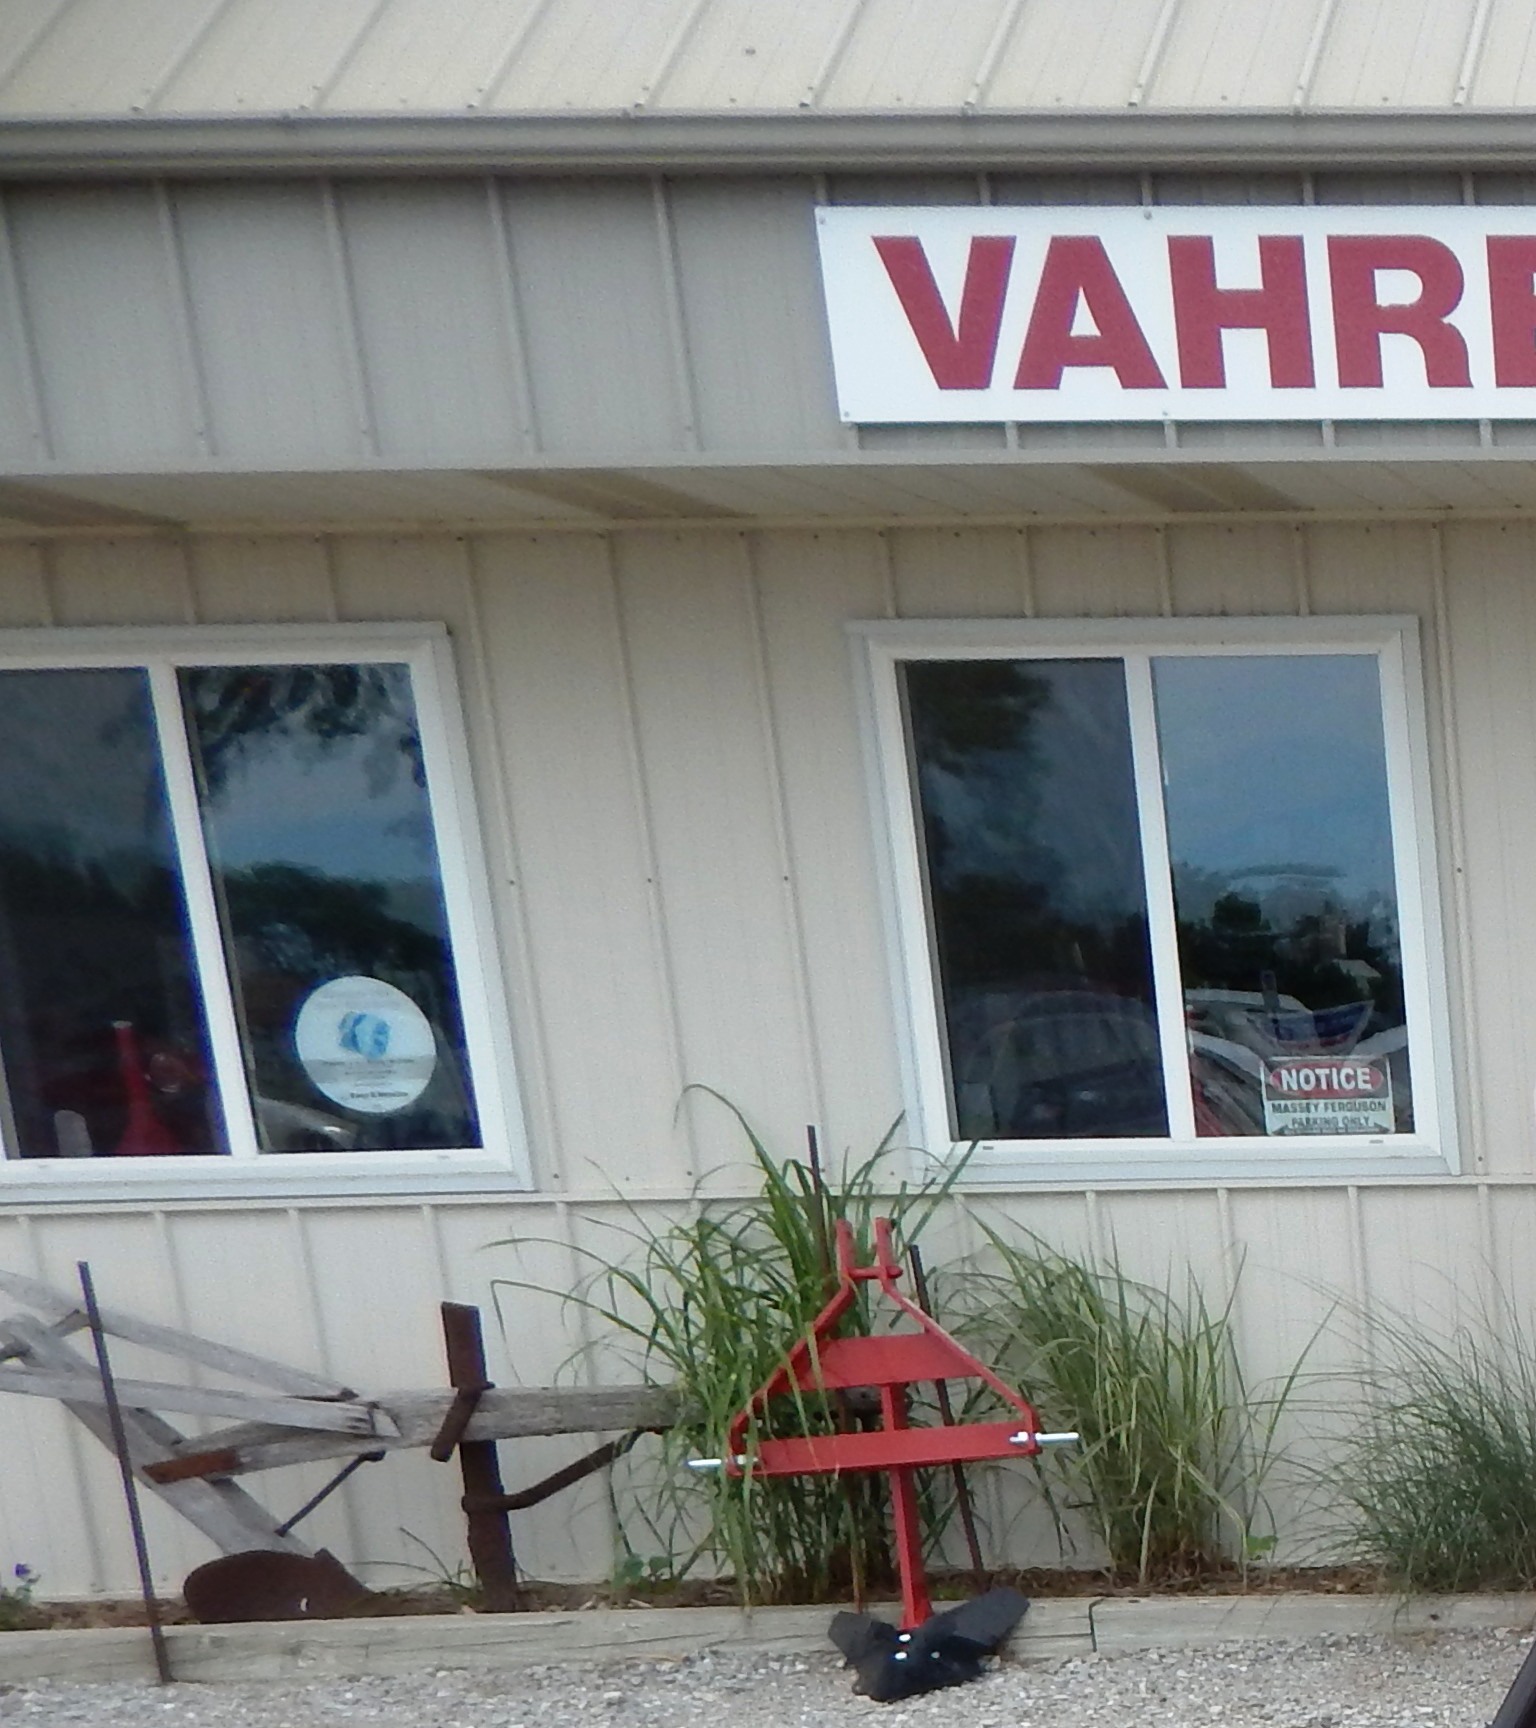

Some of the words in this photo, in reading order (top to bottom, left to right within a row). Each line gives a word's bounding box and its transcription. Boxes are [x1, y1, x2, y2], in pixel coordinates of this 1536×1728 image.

[1281, 1067, 1373, 1091] NOTICE
[1272, 1102, 1320, 1113] MASSEY
[1324, 1101, 1387, 1113] FERGUSON
[1292, 1116, 1338, 1127] PARKING
[1342, 1116, 1371, 1126] ONLY
